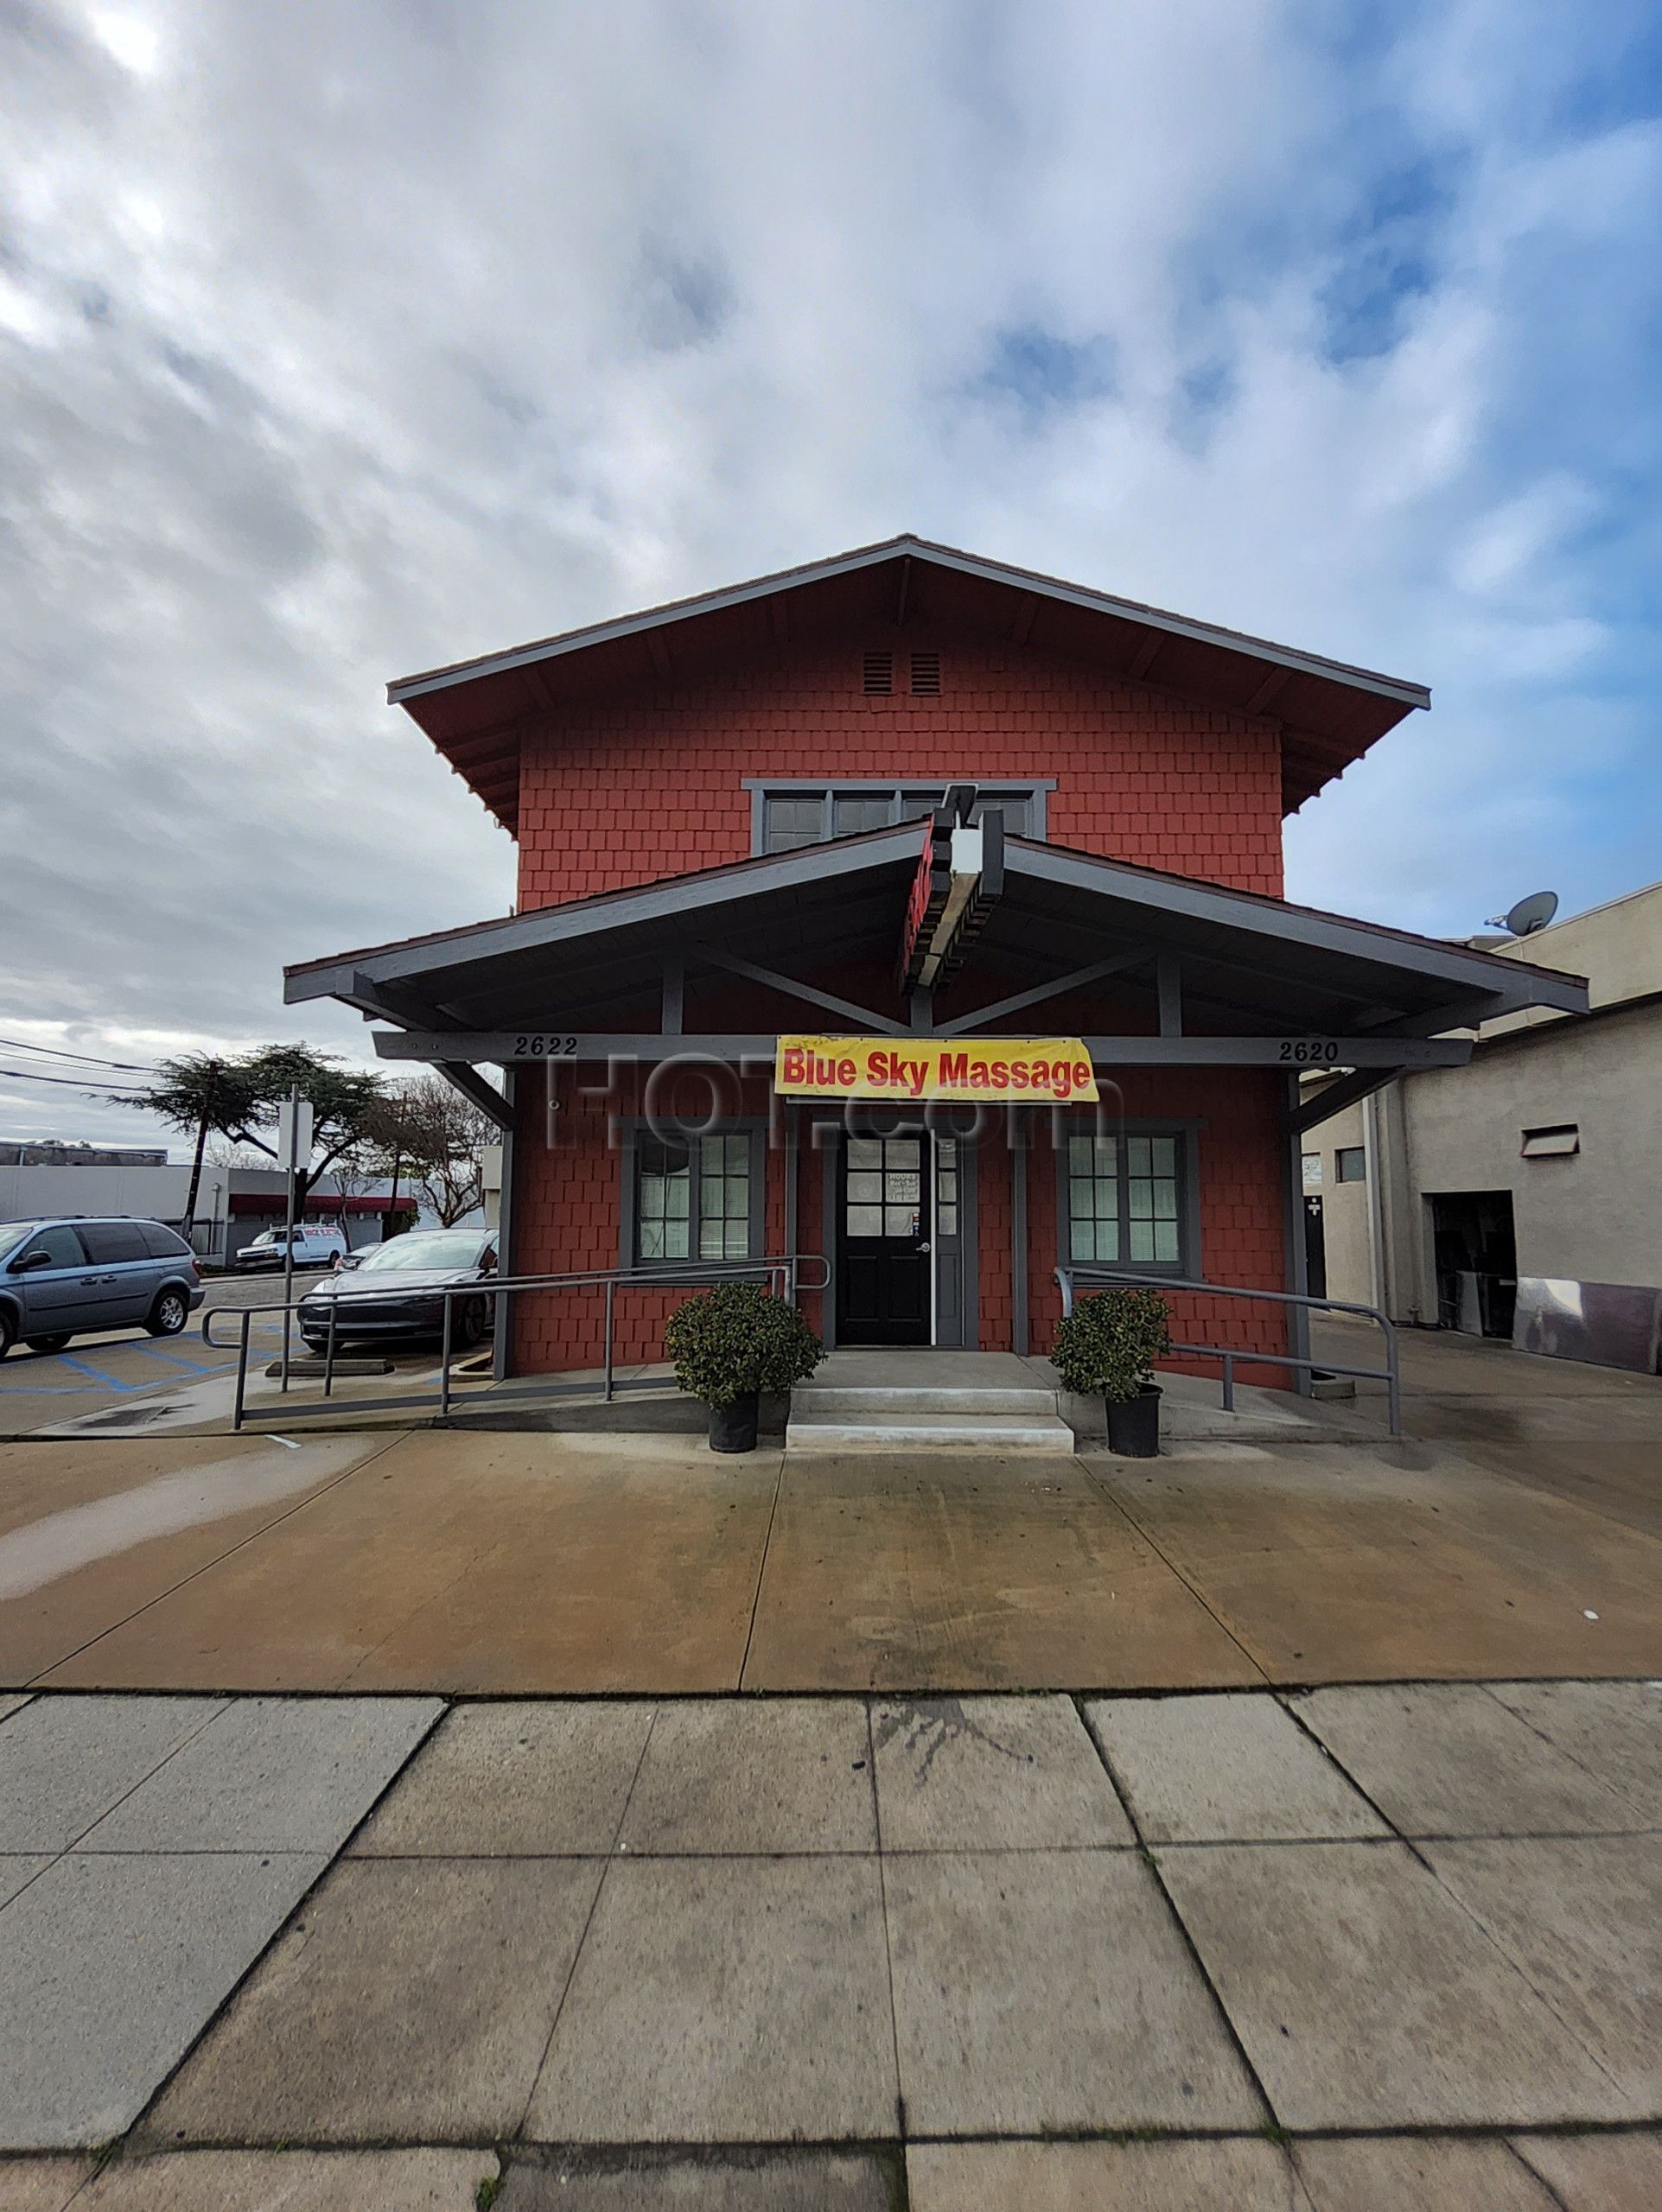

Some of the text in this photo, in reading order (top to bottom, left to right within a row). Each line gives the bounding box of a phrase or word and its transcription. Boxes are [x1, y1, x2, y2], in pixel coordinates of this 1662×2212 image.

[514, 1037, 577, 1055] 2622
[1279, 1042, 1338, 1061] 2620
[783, 1048, 1091, 1098] Blue Sky Massage
